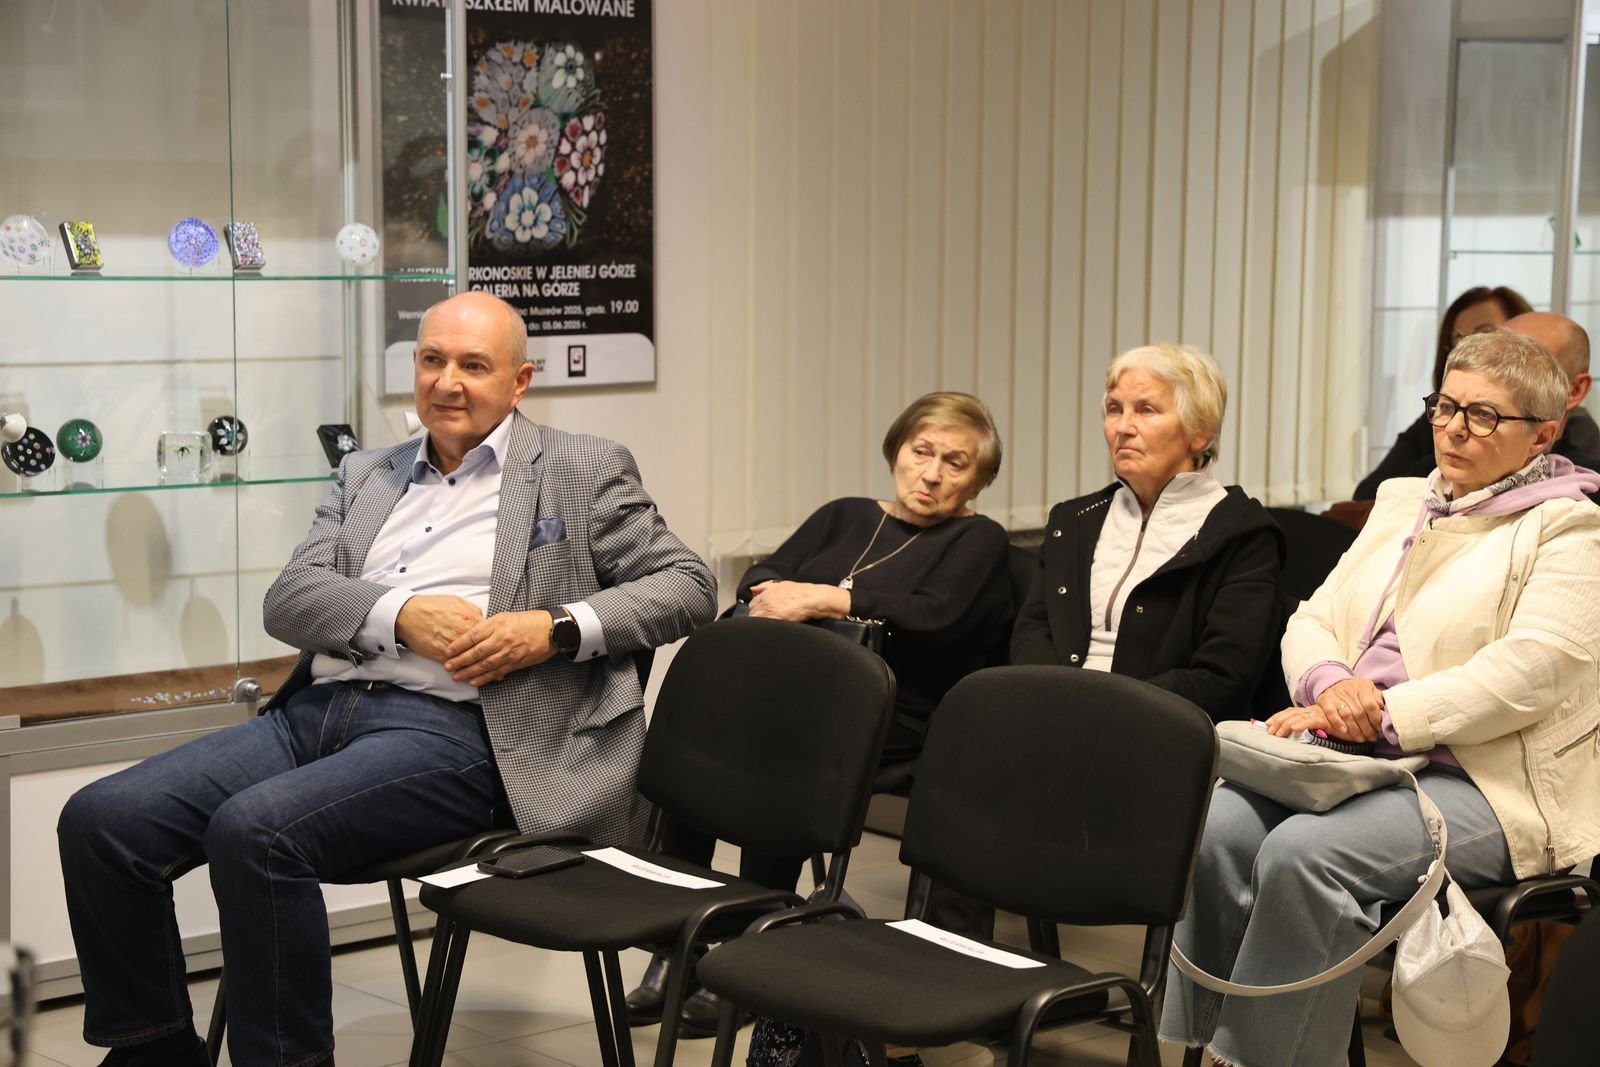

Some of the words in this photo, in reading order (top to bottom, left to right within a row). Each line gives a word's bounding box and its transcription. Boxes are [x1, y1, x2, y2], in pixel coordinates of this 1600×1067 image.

[533, 0, 636, 18] MALOWANE
[468, 266, 533, 281] RKONOSKIE
[536, 266, 548, 279] W
[549, 265, 597, 280] JELENIEJ
[599, 261, 637, 278] GÓRZE
[522, 283, 540, 297] NA
[541, 280, 581, 297] GÓRZE
[610, 299, 639, 314] 19.00
